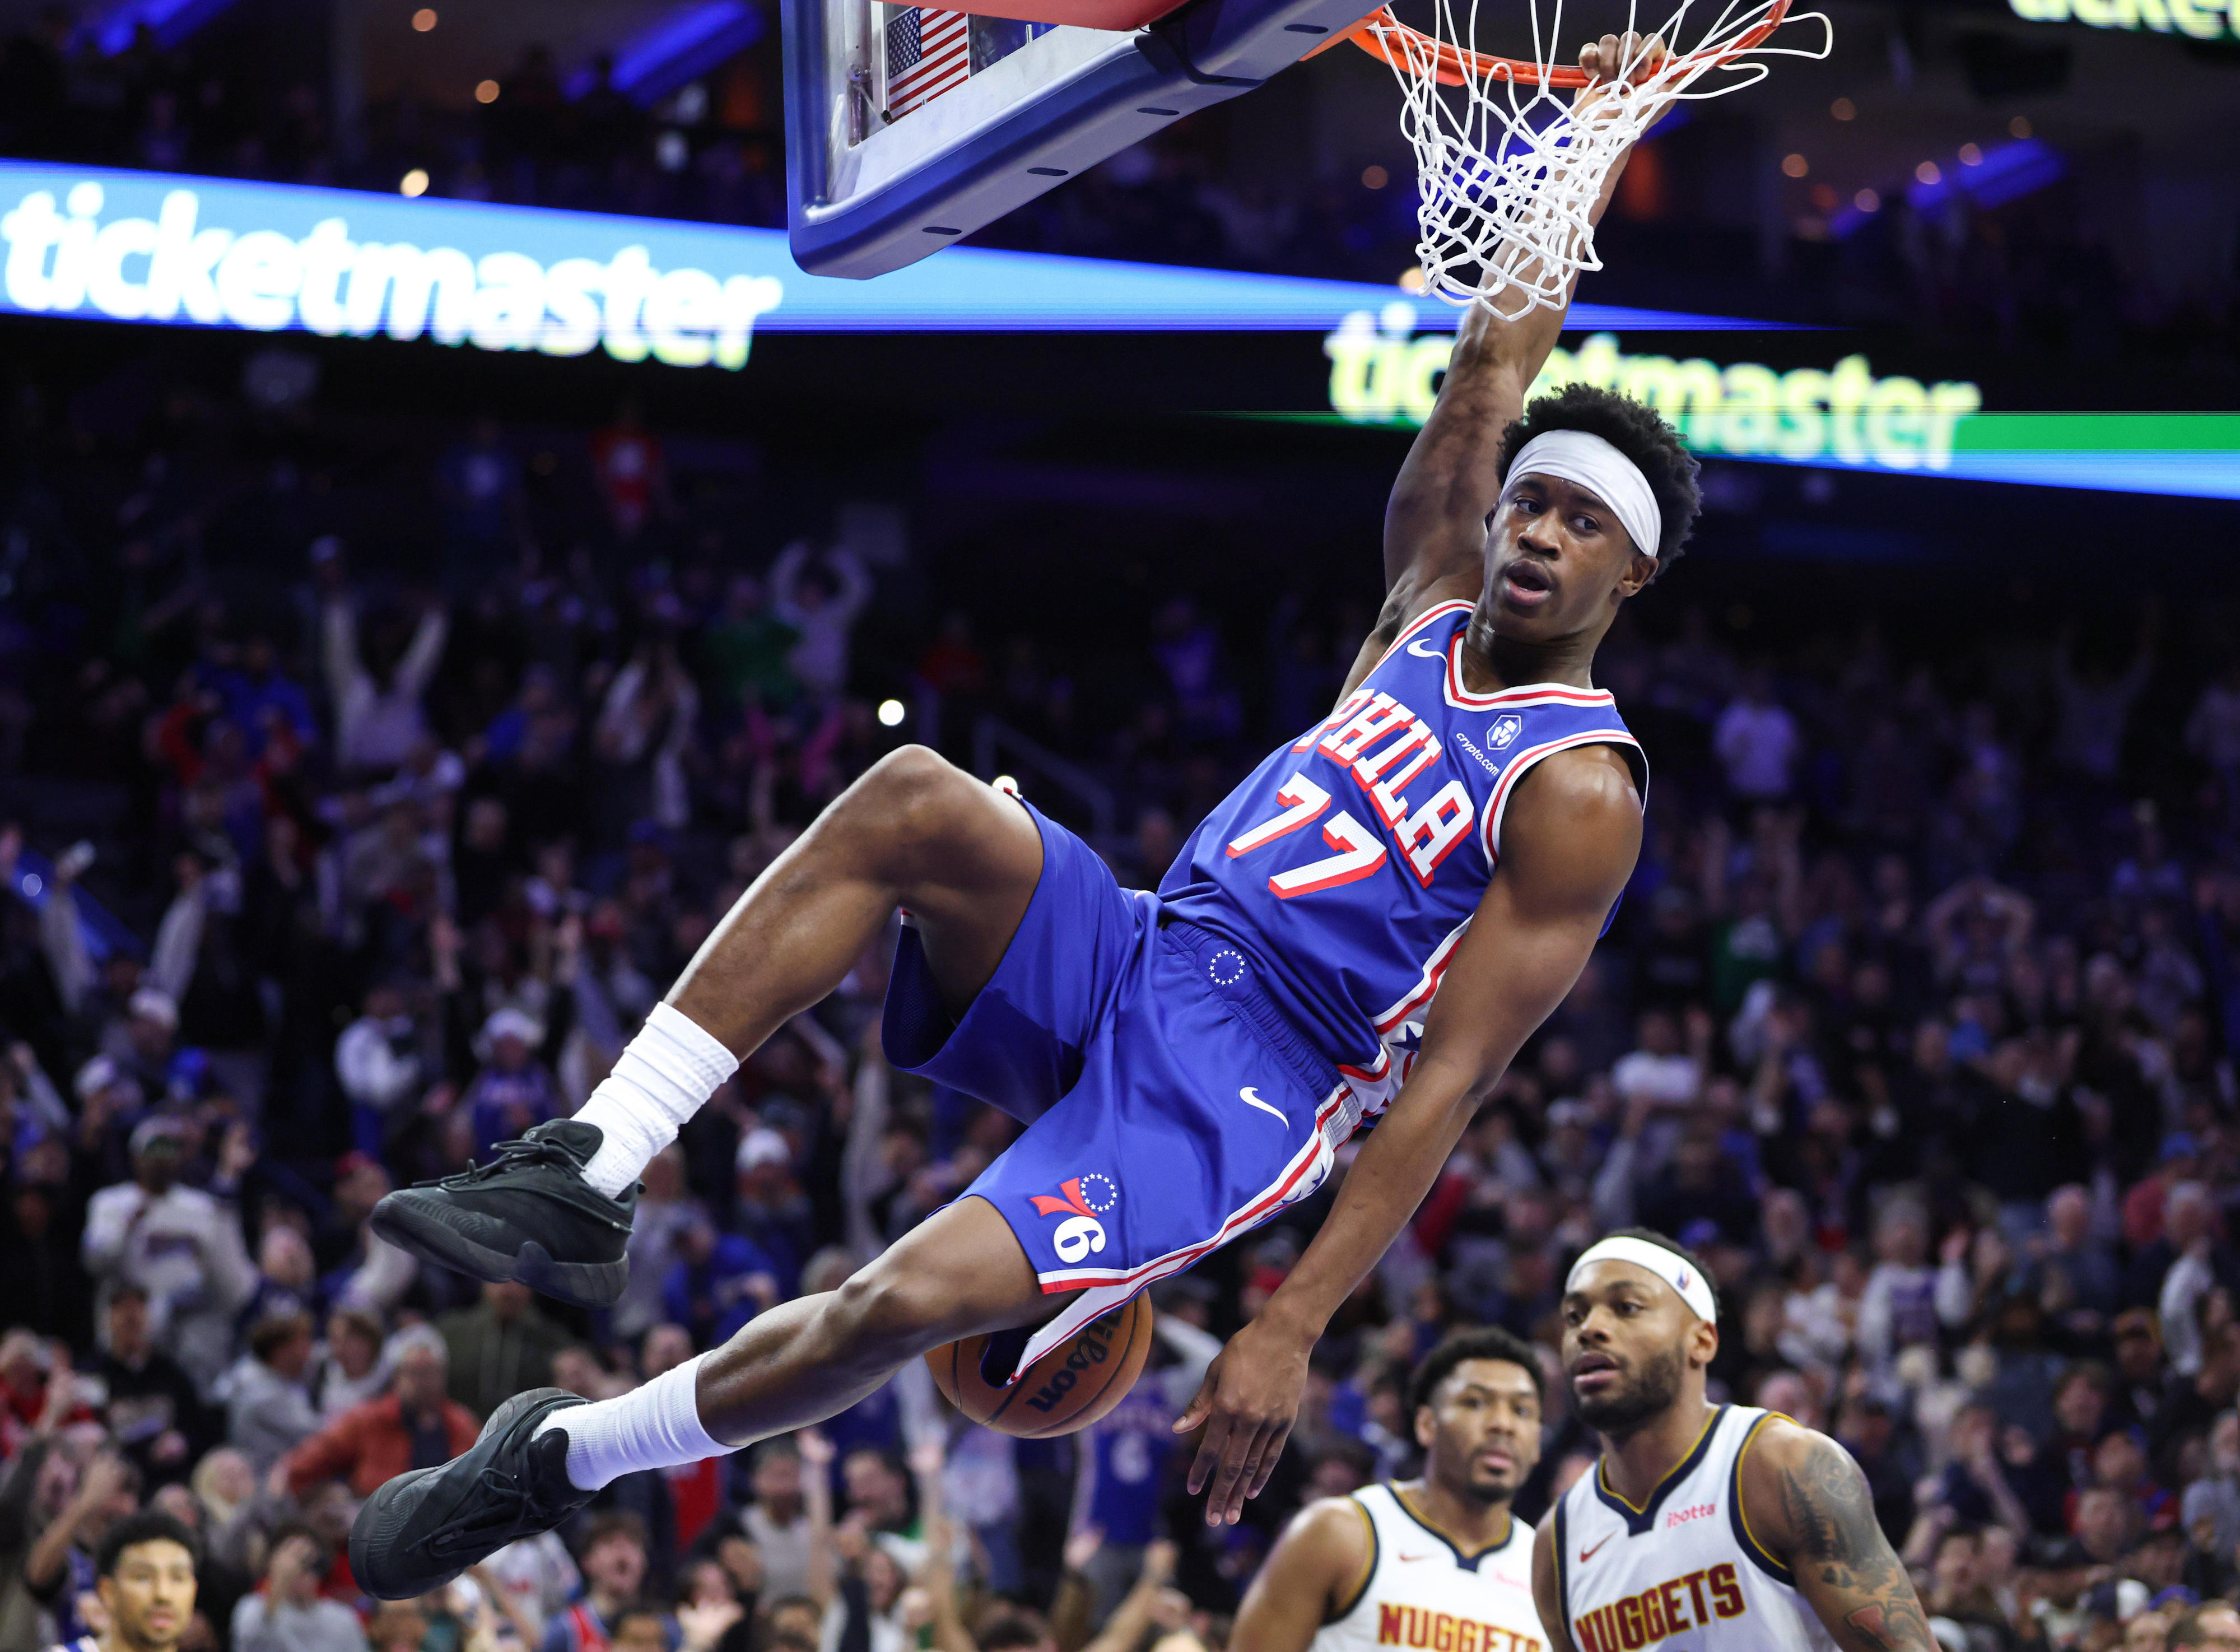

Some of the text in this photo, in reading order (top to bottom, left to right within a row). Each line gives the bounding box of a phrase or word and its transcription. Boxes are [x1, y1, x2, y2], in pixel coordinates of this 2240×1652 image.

[0, 181, 783, 370] ticketmaster
[1291, 688, 1474, 888] PHILA
[1456, 732, 1499, 776] crypto.com
[1226, 771, 1387, 900] 77
[1667, 1503, 1716, 1529] ibotta
[1575, 1562, 1747, 1652] NUGGETS
